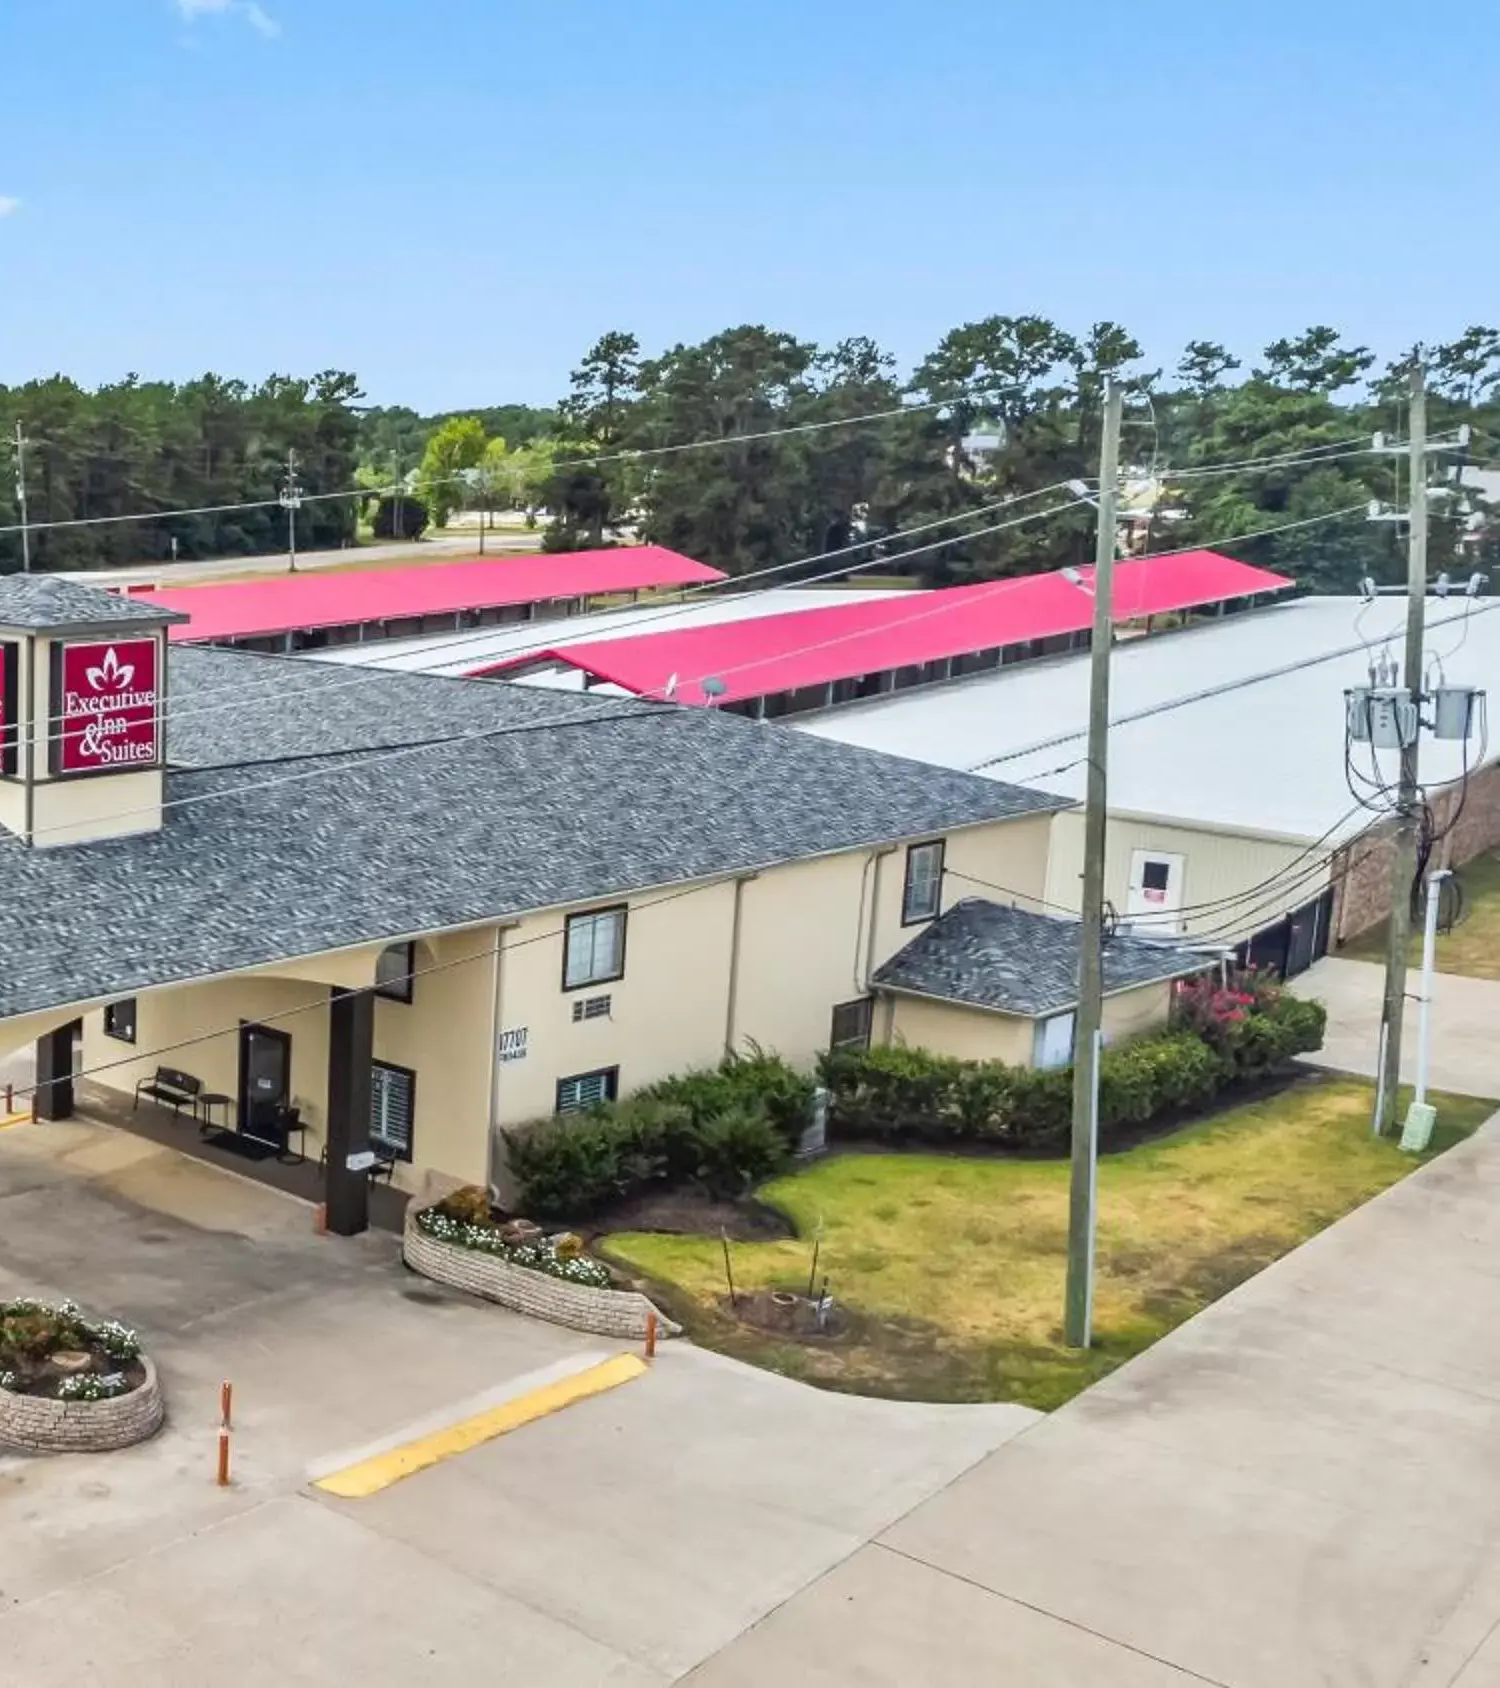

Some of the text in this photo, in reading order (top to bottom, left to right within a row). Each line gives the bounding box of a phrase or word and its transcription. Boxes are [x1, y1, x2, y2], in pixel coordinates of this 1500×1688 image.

[65, 687, 156, 716] Executive
[96, 713, 128, 736] Inn
[79, 723, 154, 763] & Suites
